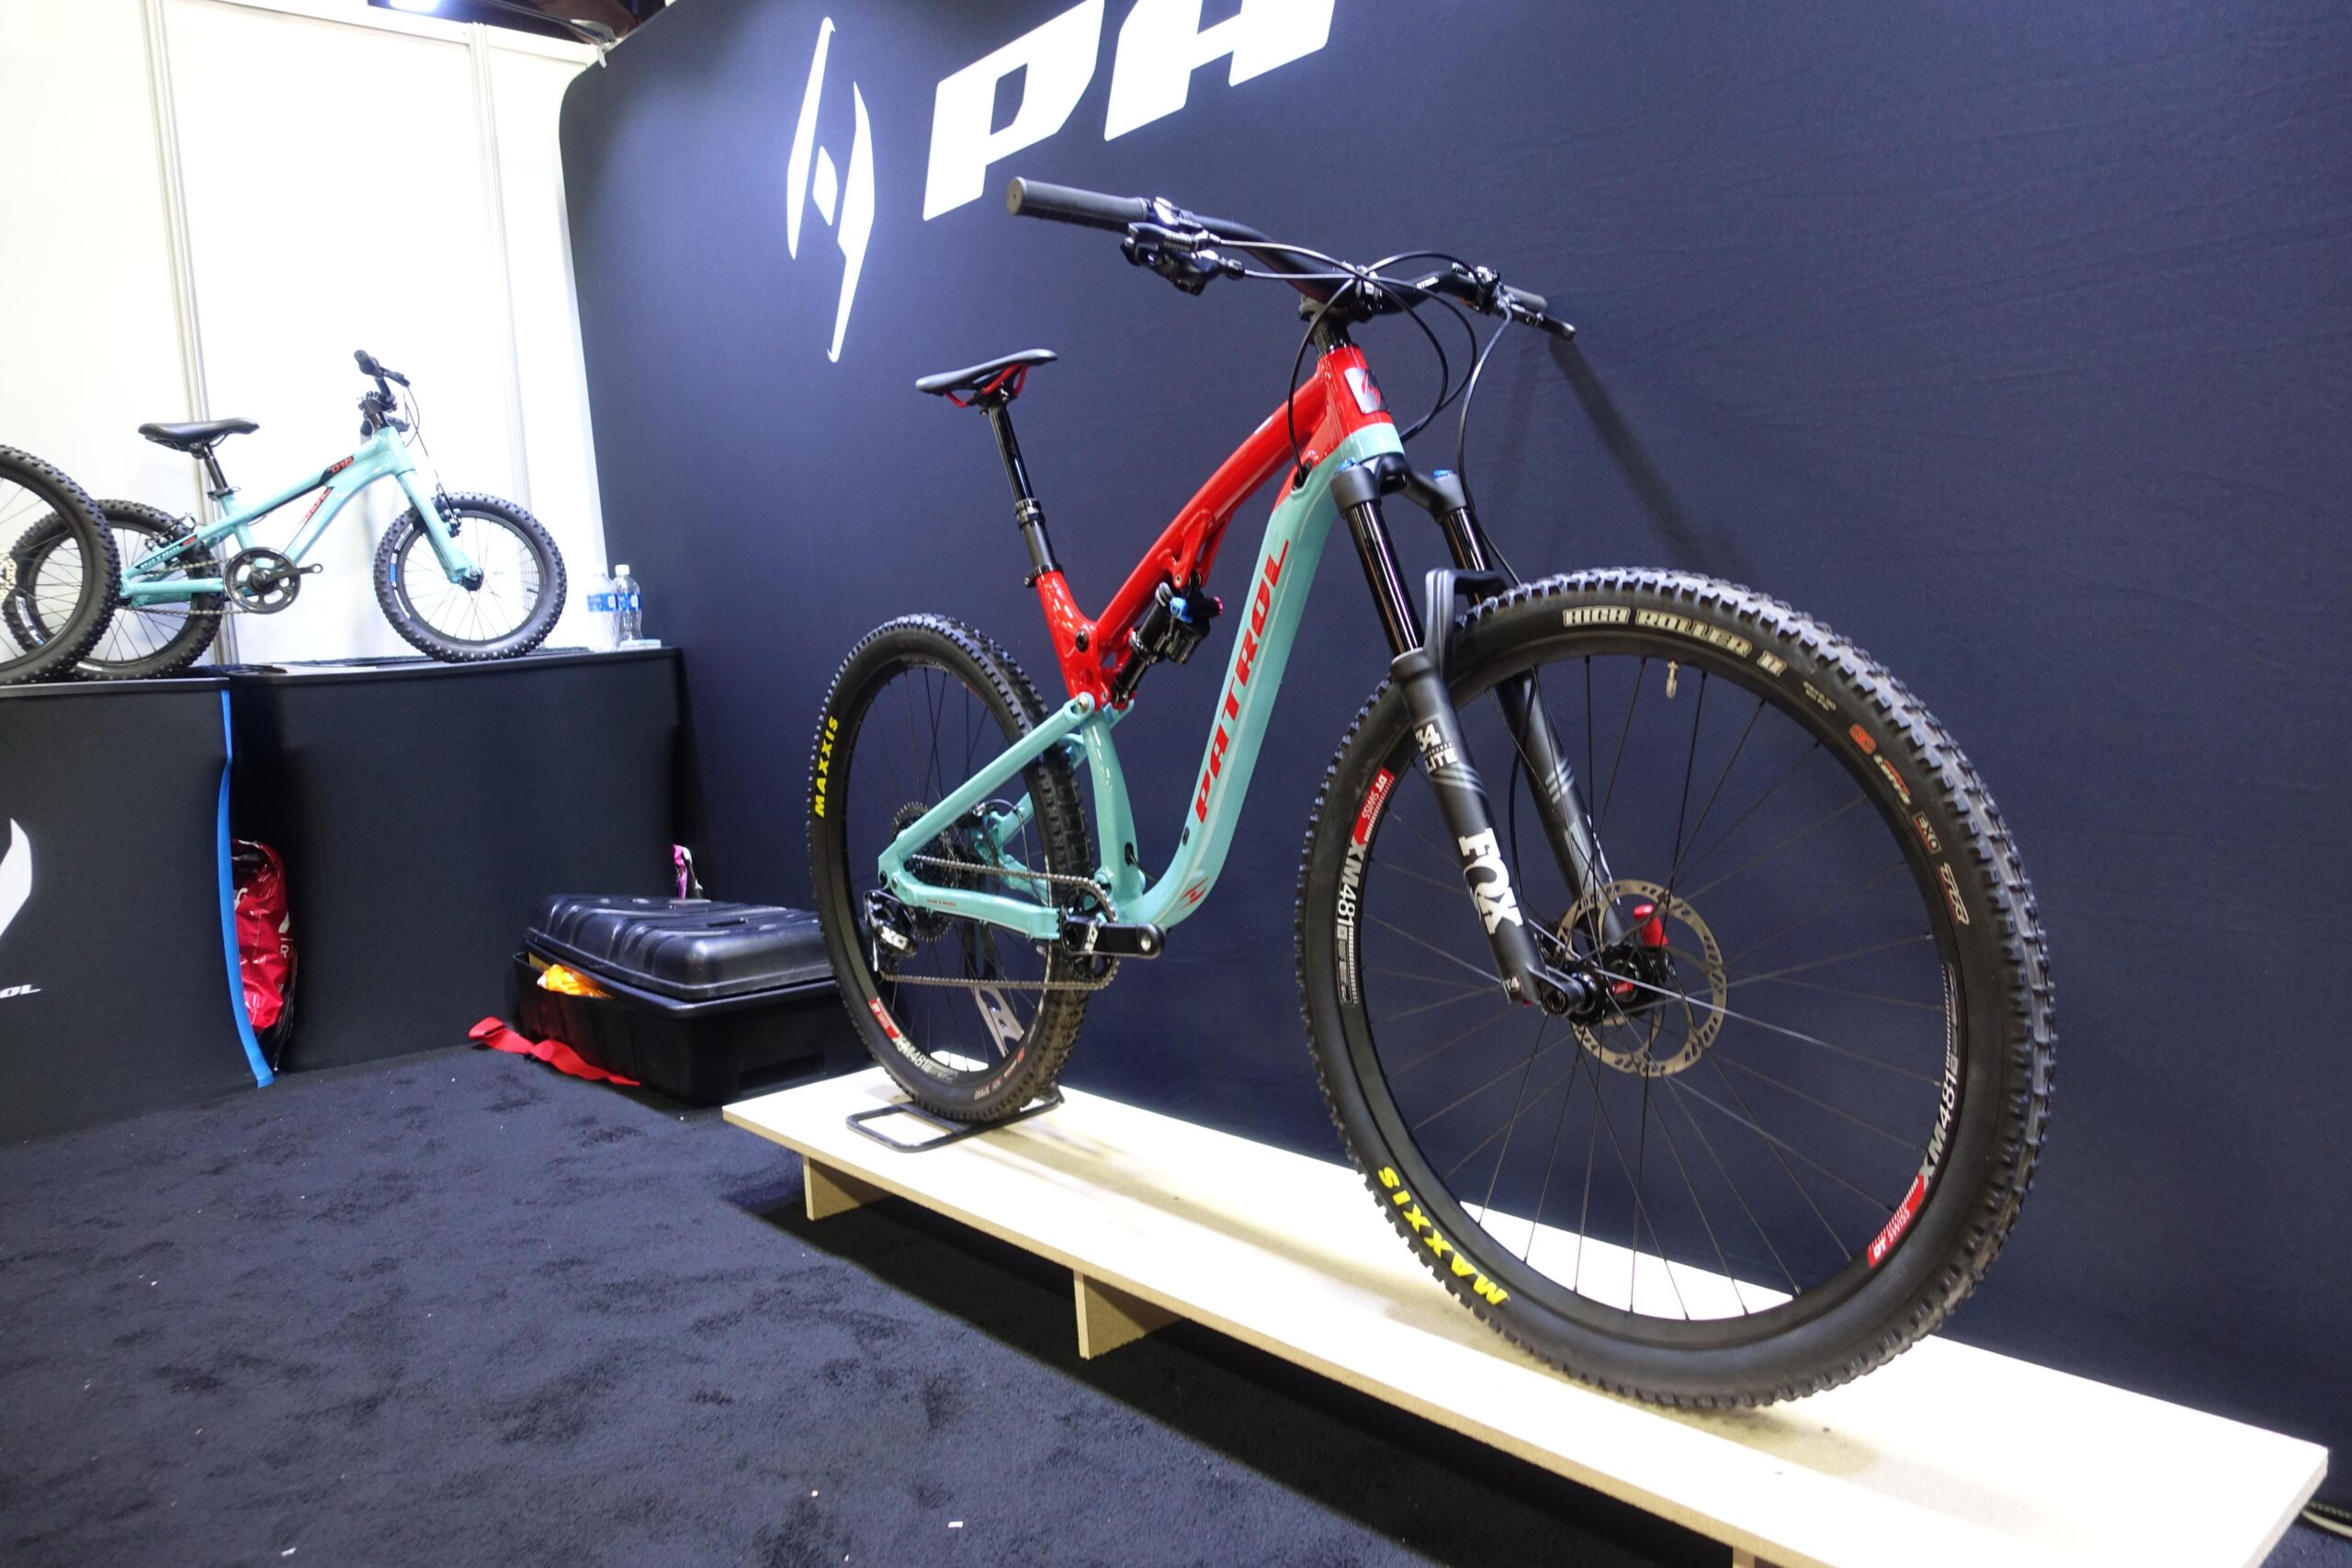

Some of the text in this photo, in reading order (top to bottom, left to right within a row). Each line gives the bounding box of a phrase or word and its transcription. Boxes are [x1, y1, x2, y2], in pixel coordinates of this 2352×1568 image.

[1563, 605, 1631, 627] HIGH
[1635, 608, 1753, 658] ROLLER
[1195, 539, 1289, 823] PATROL
[1415, 723, 1442, 753] 34
[1425, 747, 1458, 773] LITE
[814, 716, 839, 818] MAXXIS
[1362, 774, 1388, 820] DT SWISS
[1917, 812, 1939, 851] EXO
[1458, 828, 1524, 935] FOX
[1378, 1167, 1511, 1306] MAXXIS
[1886, 1208, 1911, 1244] SWISS
